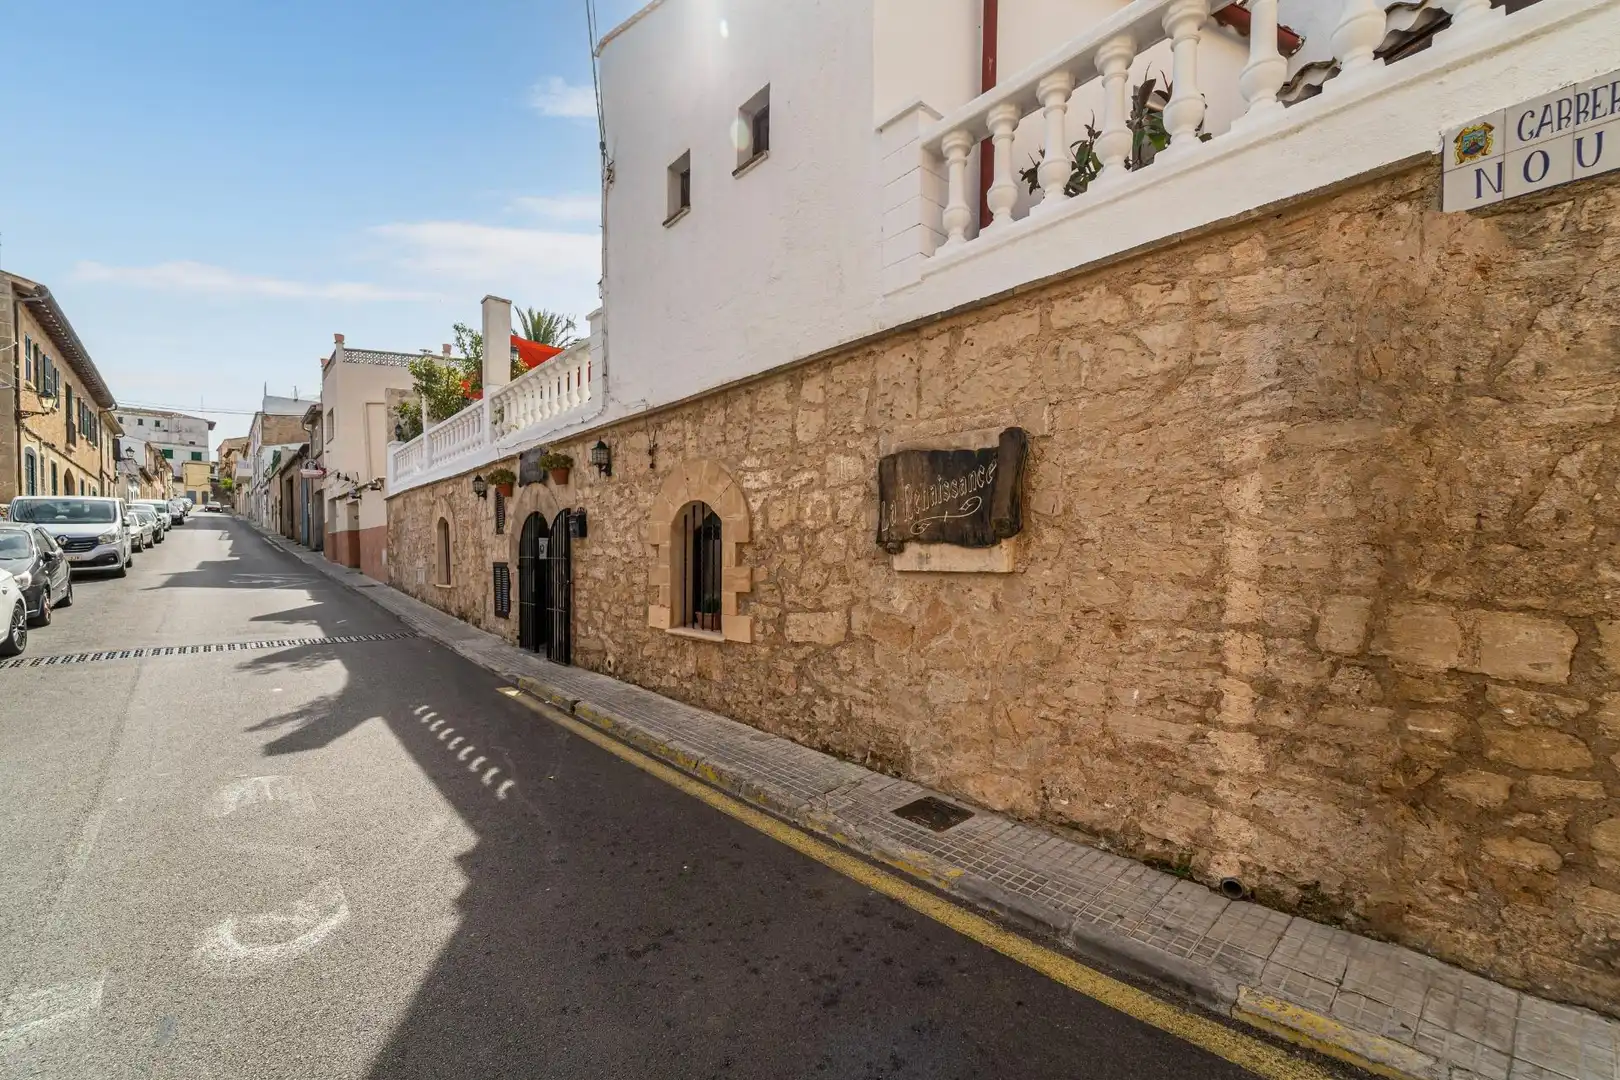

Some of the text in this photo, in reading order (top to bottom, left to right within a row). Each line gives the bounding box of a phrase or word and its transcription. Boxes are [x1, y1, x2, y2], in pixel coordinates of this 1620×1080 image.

[1474, 131, 1604, 199] NOU
[881, 460, 997, 532] La Renaissance
